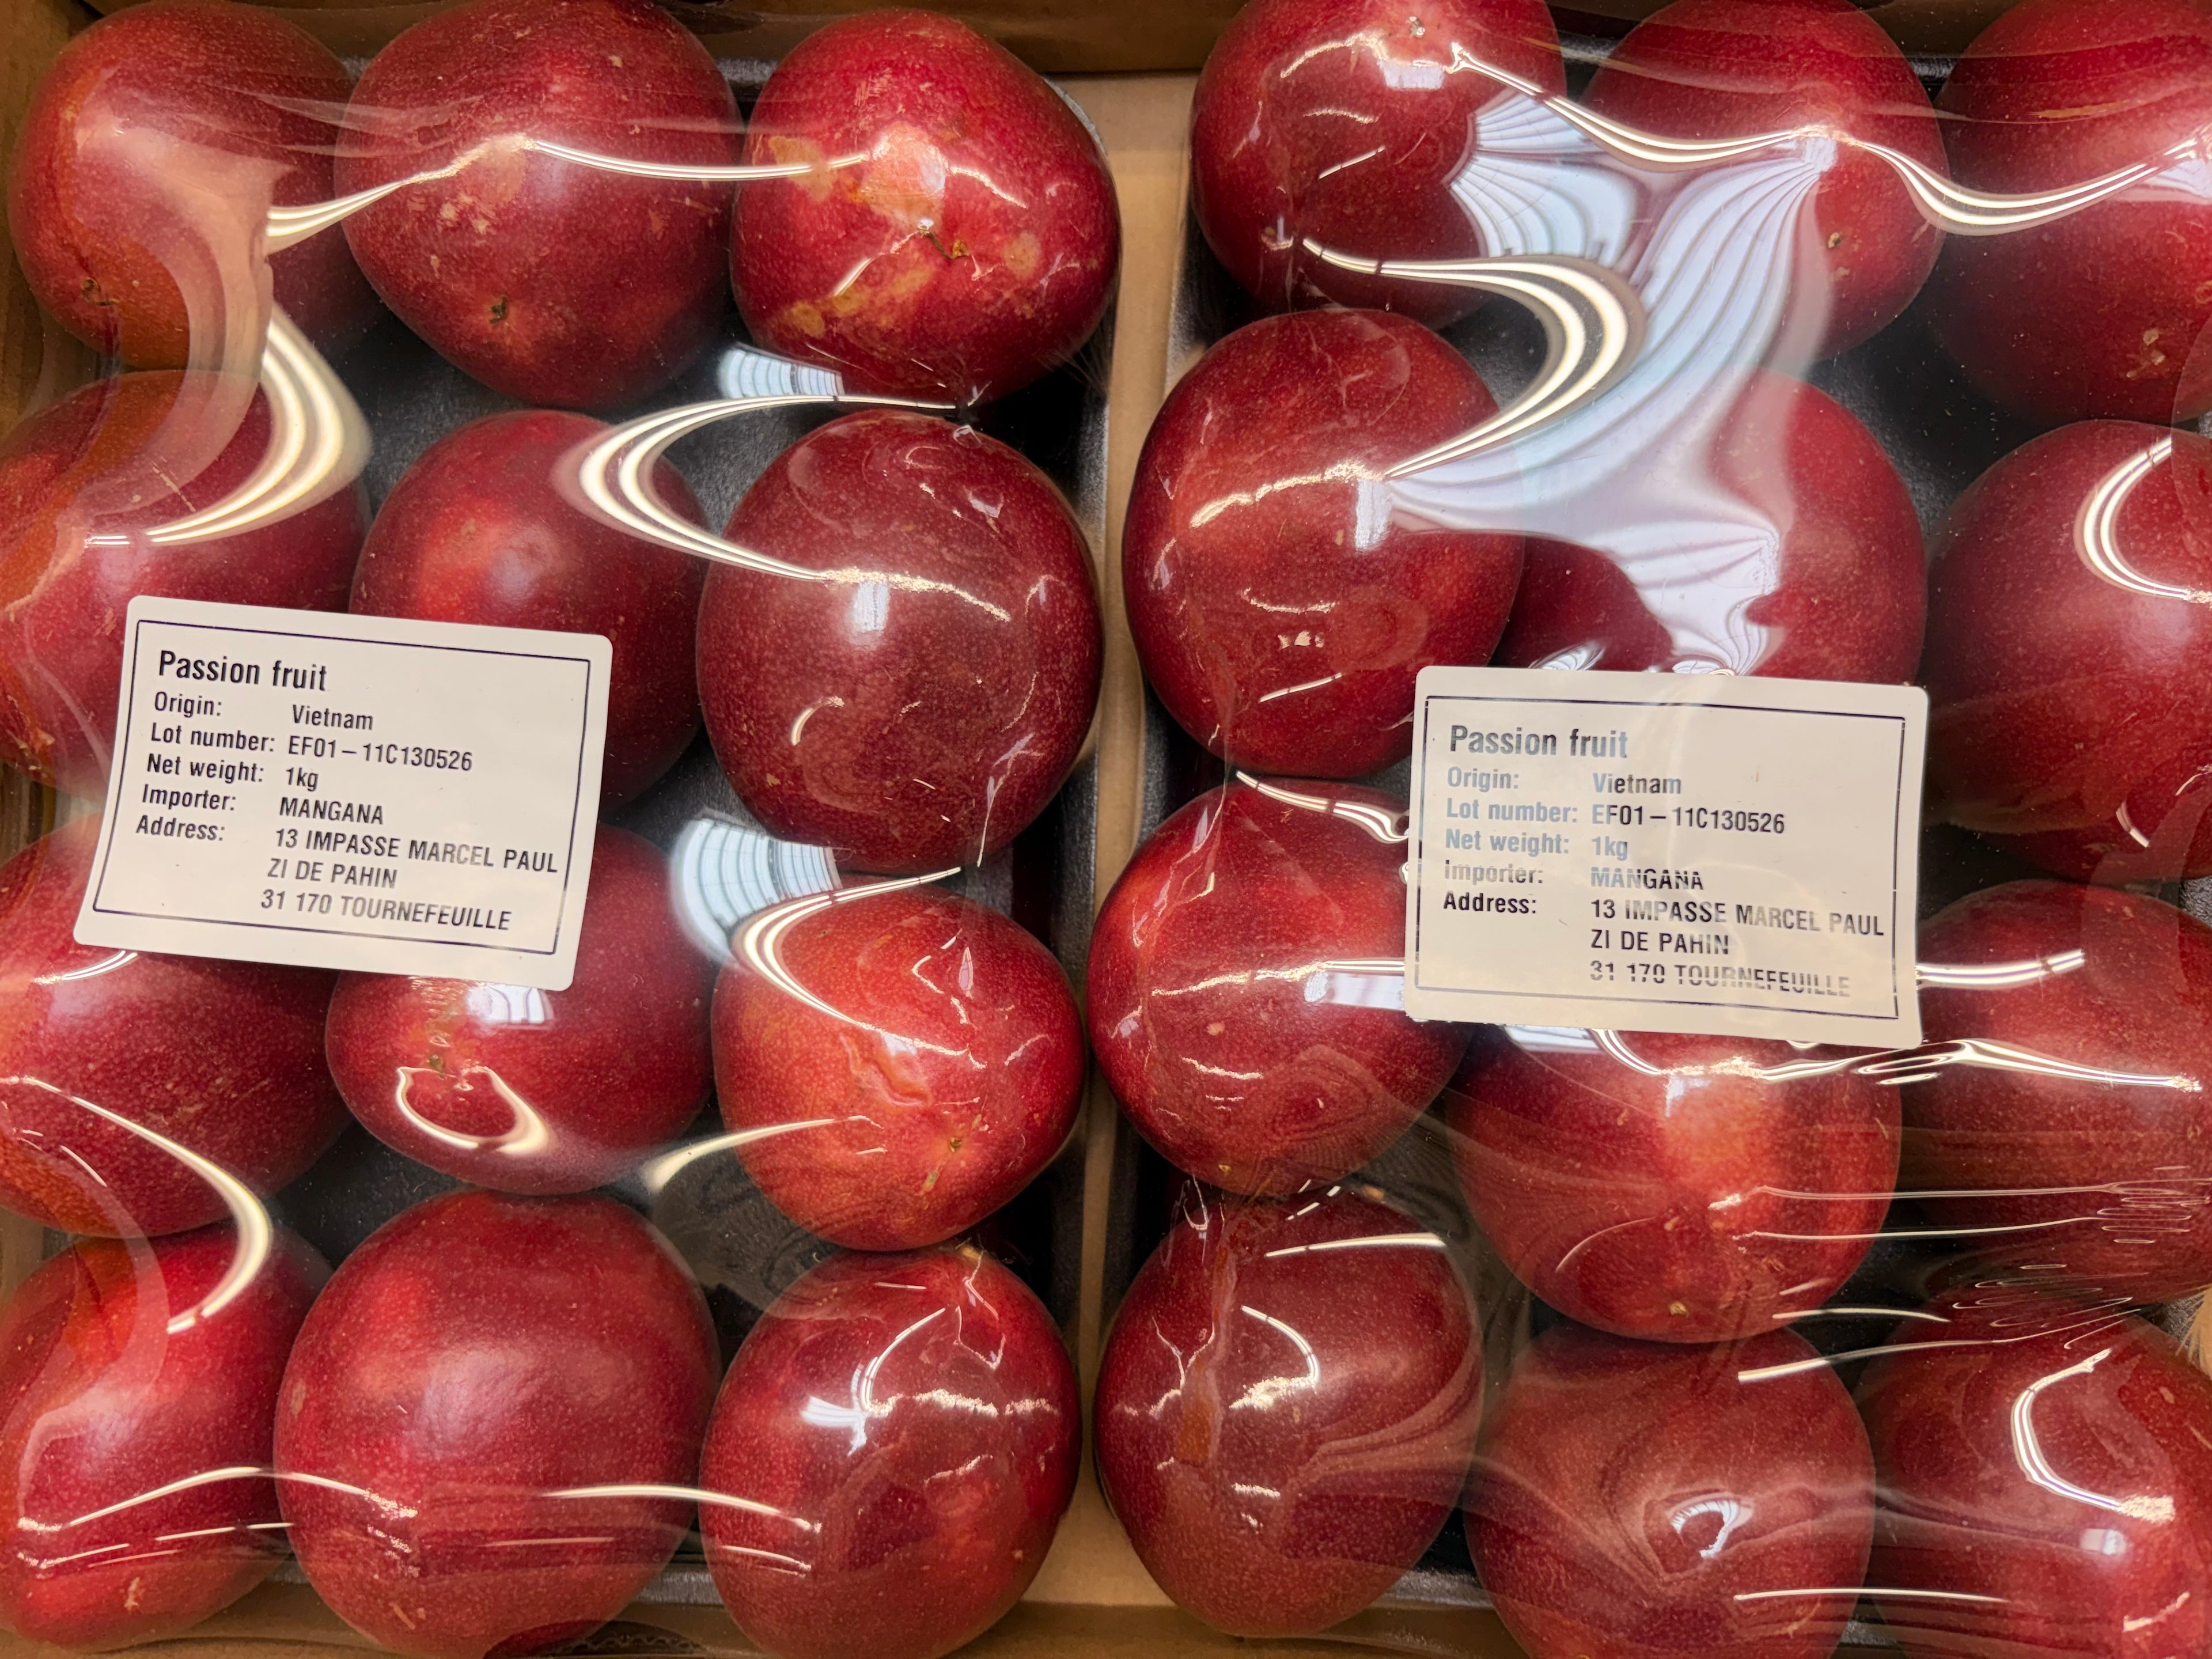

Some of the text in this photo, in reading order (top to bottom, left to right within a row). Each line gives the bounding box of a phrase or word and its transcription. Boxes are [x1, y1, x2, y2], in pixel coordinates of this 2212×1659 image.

[158, 649, 327, 692] Passion fruit
[154, 691, 374, 731] Origin: Vietnam
[150, 722, 183, 745] Lot
[190, 729, 275, 752] number:
[1450, 725, 1628, 759] Passion fruit
[146, 752, 319, 793] Net weight: 1kg
[1448, 766, 1681, 794] Origin: Vietnam
[142, 783, 384, 825] Importer: MANGANA
[1446, 797, 1479, 820] Lot
[1488, 801, 1577, 823] number:
[135, 814, 558, 873] Address: 13 IMPASSE MARCEL PAUL
[1445, 828, 1628, 861] Net weight: 1kg
[267, 857, 398, 889] ZI DE PAHIN
[1445, 859, 1705, 891] Importer: MANGANA
[260, 888, 512, 931] 31 170 TOURNEFEUILLE
[1442, 891, 1885, 937] Address: 13 IMPASSE MARCEL PAUL
[1590, 929, 1729, 955] ZI DE PAHIN
[1590, 960, 1851, 997] 31 170 TOURNEFEUILLE
